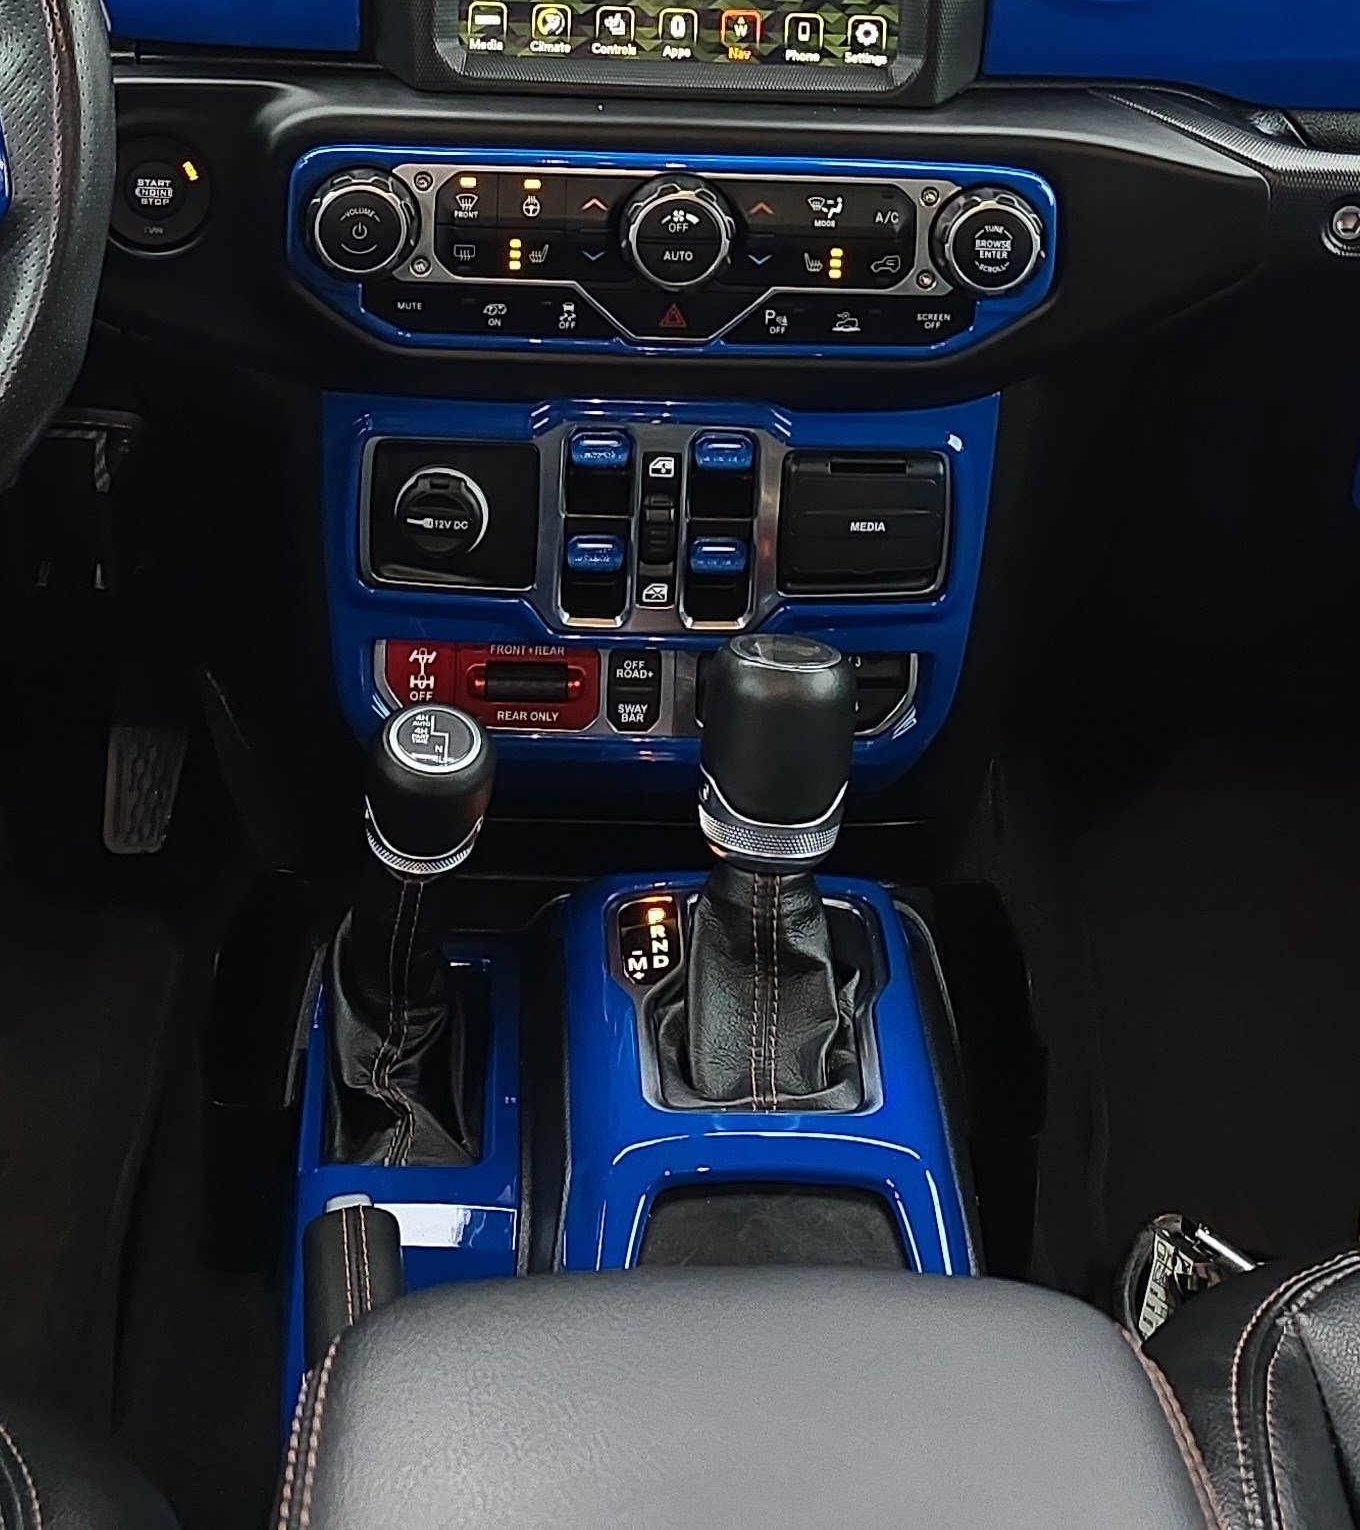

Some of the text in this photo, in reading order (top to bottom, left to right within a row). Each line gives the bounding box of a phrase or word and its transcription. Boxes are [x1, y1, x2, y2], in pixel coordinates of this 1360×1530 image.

[468, 38, 504, 52] Media
[529, 40, 572, 54] Climate
[591, 43, 638, 57] Controls
[662, 44, 692, 60] Apps
[728, 46, 752, 61] Nav
[785, 48, 821, 63] Phone
[844, 51, 888, 67] Settings
[137, 179, 171, 187] START
[140, 198, 170, 206] STOP
[345, 207, 375, 217] VOLUME
[454, 210, 479, 219] FRONT
[875, 211, 899, 225] A/C
[668, 223, 689, 233] OFF
[814, 219, 835, 228] MODE
[984, 225, 1004, 234] TUNE
[976, 240, 1011, 248] BROWSE
[663, 250, 693, 261] AUTO
[980, 250, 1008, 259] ENTER
[397, 301, 422, 311] MUTE
[488, 317, 501, 327] ON
[916, 313, 951, 322] SCREEN
[558, 320, 576, 330] OFF
[769, 325, 786, 335] OFF
[924, 320, 940, 330] OFF
[434, 520, 469, 530] 12V DC
[850, 521, 886, 532] MEDIA
[624, 660, 645, 670] OFF
[409, 690, 433, 702] OFF
[617, 703, 648, 715] SWAY
[497, 710, 559, 722] REAR ONLY
[621, 712, 644, 723] BAR
[434, 744, 444, 753] N
[650, 924, 666, 939] R
[652, 938, 669, 954] N
[627, 956, 648, 972] M
[653, 955, 670, 969] D
